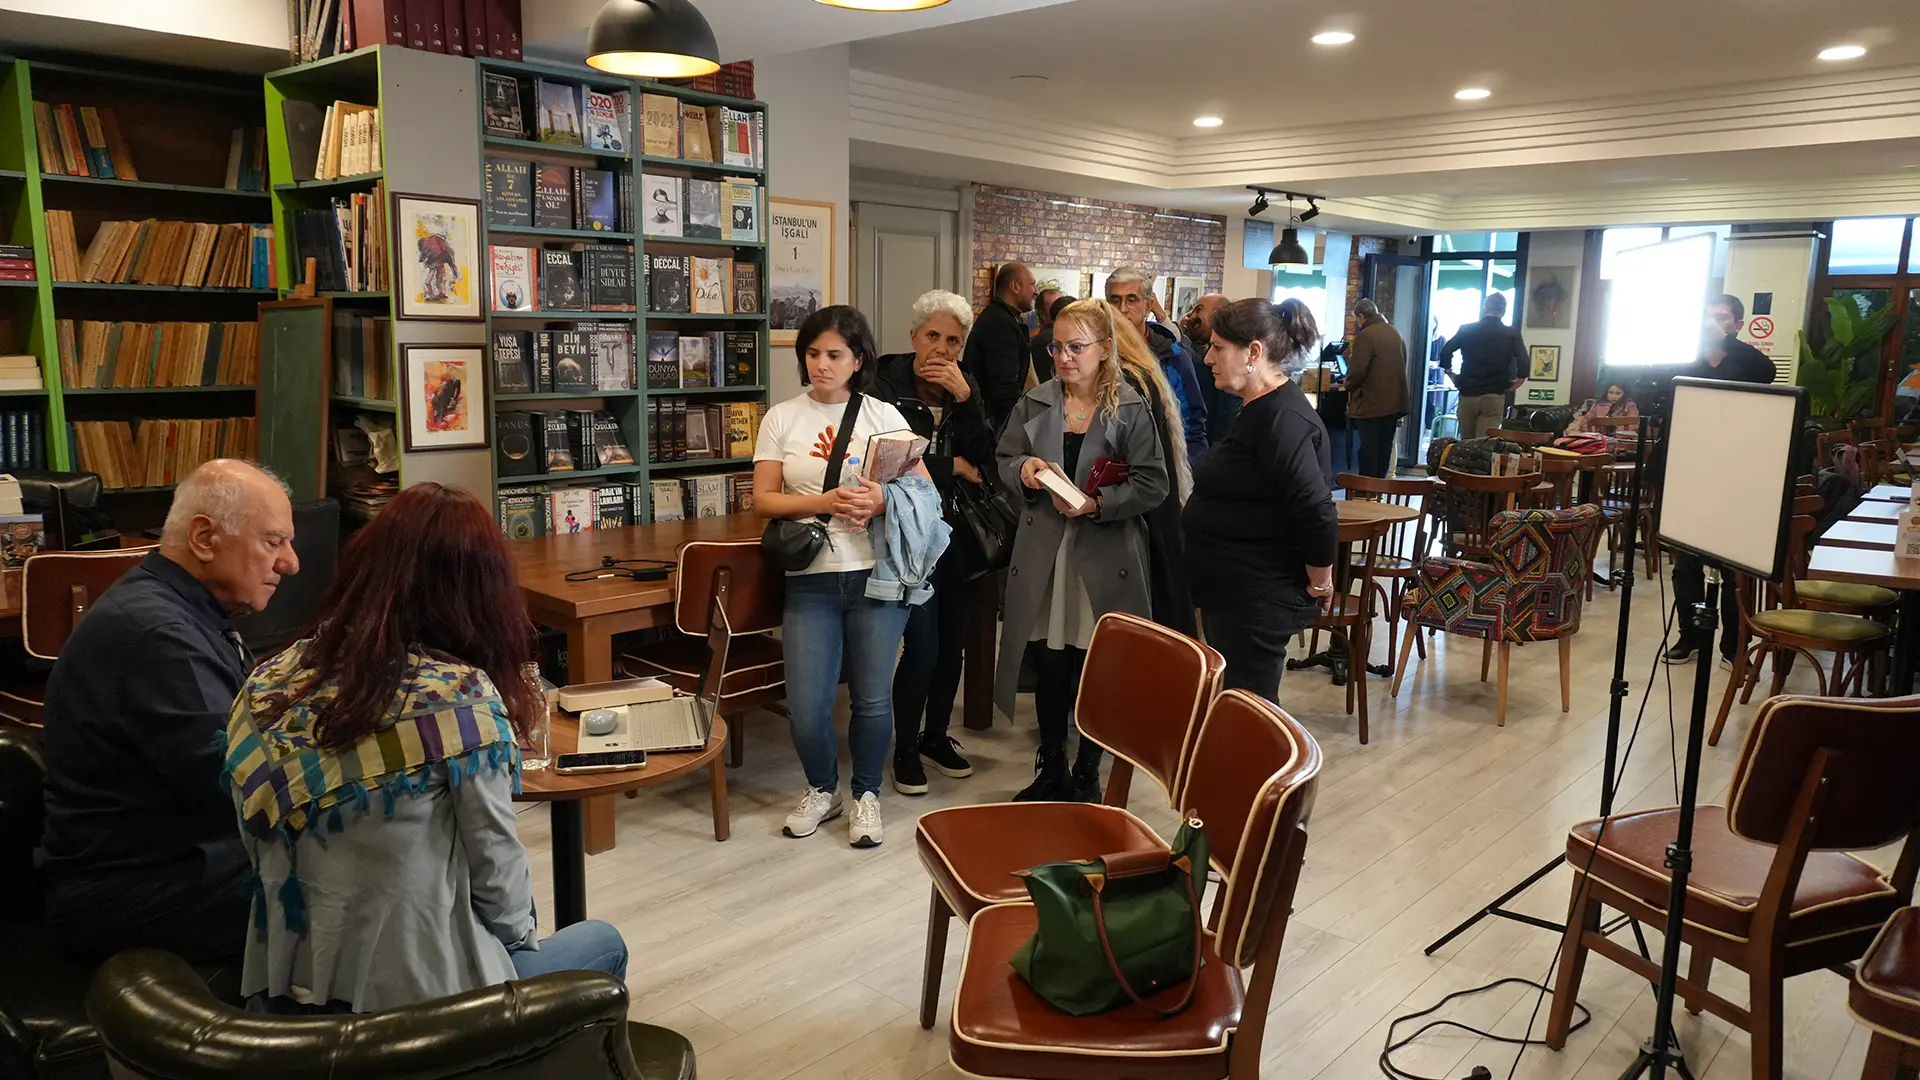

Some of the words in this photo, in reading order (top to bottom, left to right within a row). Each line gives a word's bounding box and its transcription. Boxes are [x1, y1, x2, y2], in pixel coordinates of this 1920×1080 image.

[728, 111, 748, 123] LLAH
[494, 163, 527, 174] ALLAH
[508, 180, 514, 190] 7
[772, 213, 817, 229] İSTANBUL'UN
[781, 227, 809, 240] İŞGALİ
[792, 246, 798, 260] 1
[546, 253, 573, 266] ECCAL
[653, 257, 681, 270] DECCAL
[557, 343, 587, 355] BEYİN
[600, 495, 624, 506] LANLARI
